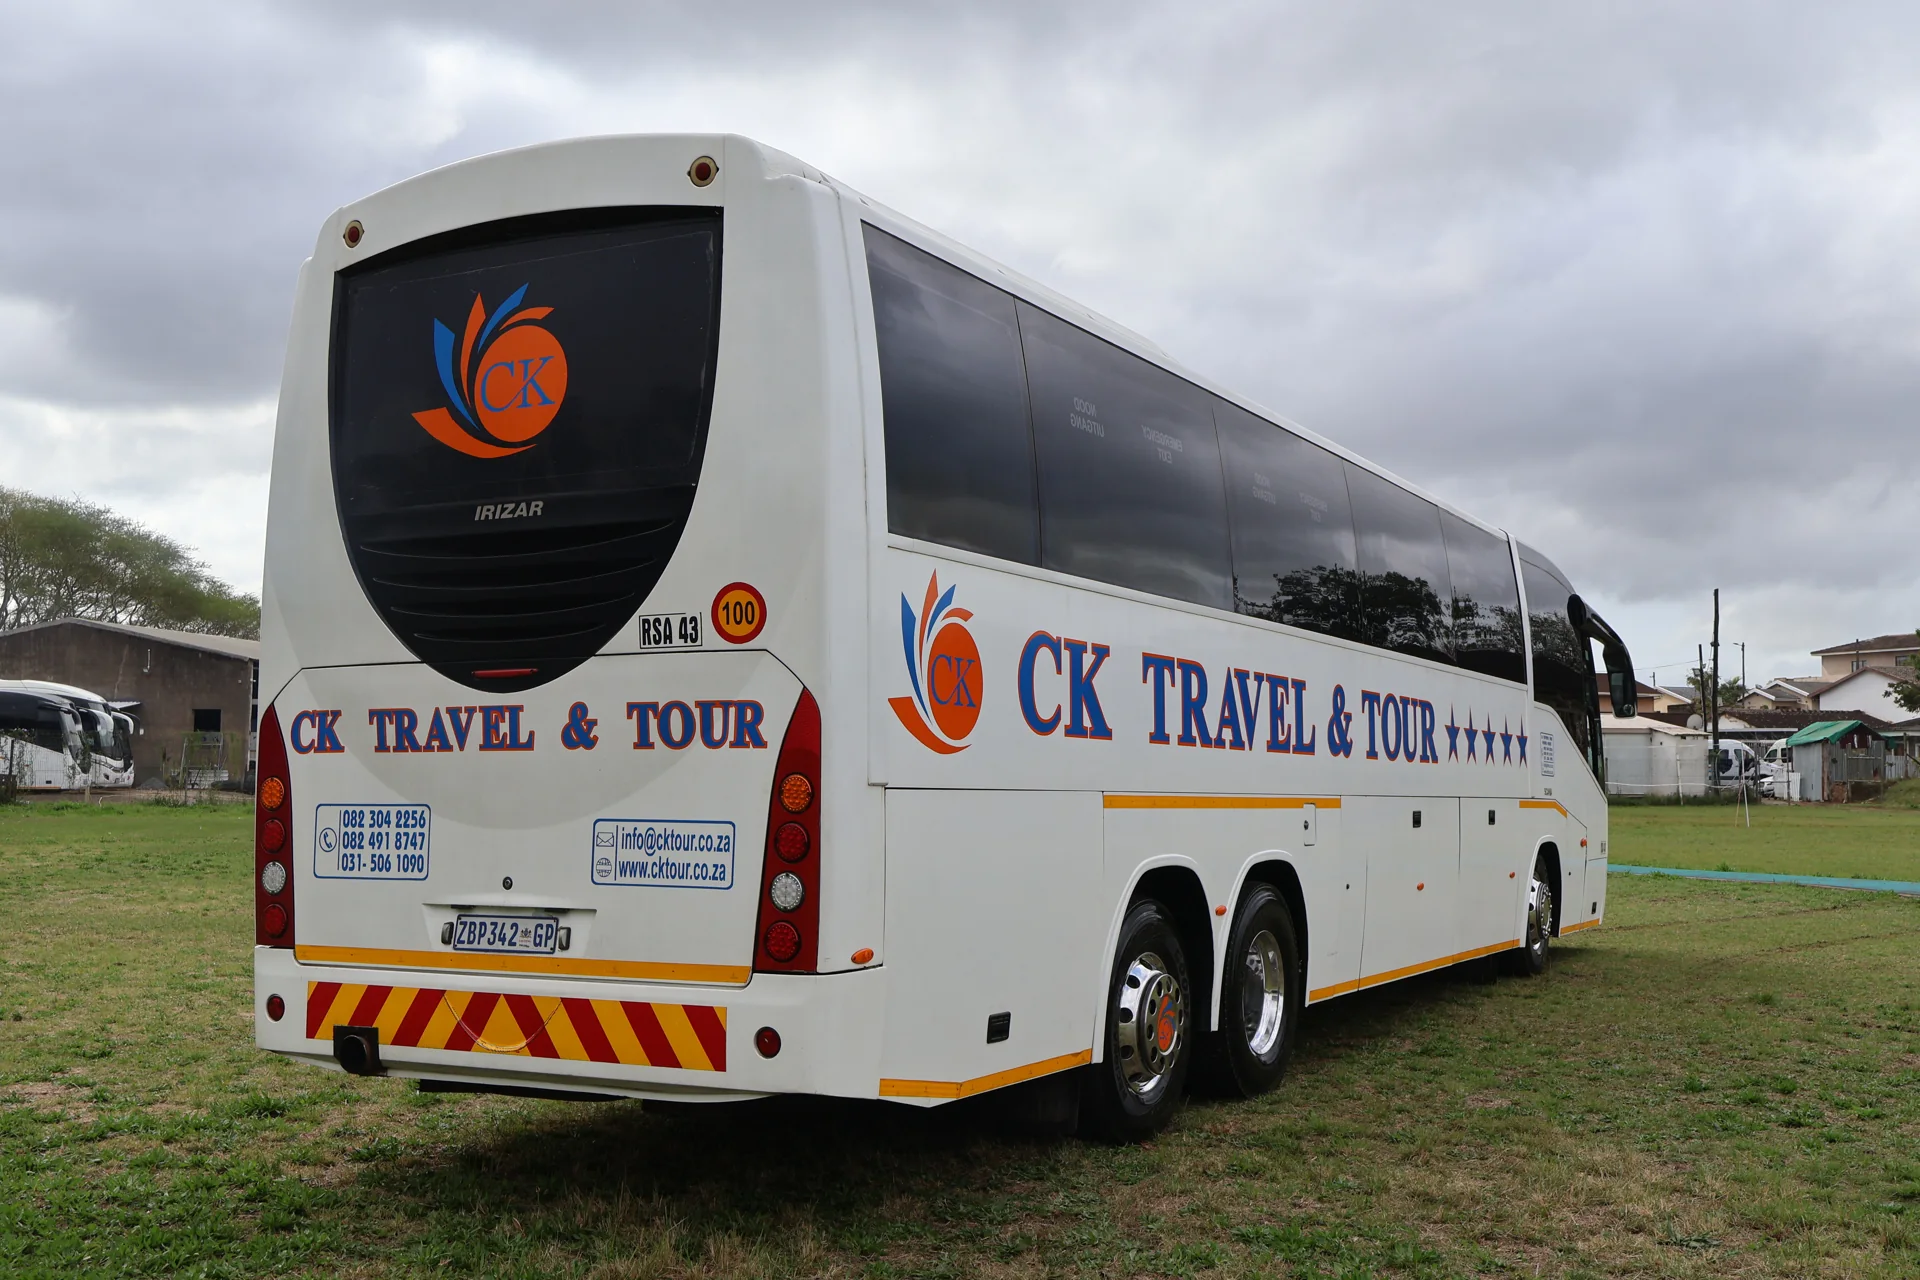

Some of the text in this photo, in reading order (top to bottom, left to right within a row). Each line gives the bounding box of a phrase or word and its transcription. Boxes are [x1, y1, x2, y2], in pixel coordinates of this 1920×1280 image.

[480, 355, 556, 413] CK
[474, 500, 544, 521] IRIZAR
[722, 600, 755, 626] 100
[641, 615, 699, 646] RSA 43
[930, 652, 977, 709] CK
[1017, 630, 1113, 742] CK
[1141, 652, 1316, 756] TRAVEL
[1327, 684, 1353, 758] &
[1361, 689, 1439, 764] TOUR
[290, 699, 768, 755] CK TRAVEL & TOUR
[342, 809, 426, 829] 082 304 2256
[342, 831, 426, 850] 082 491 8747
[621, 826, 731, 857] info@cktour.co.za
[341, 853, 425, 873] 031- 506 1090
[619, 856, 726, 882] www.cktour.co.za
[456, 920, 555, 948] ZBP342 GP
